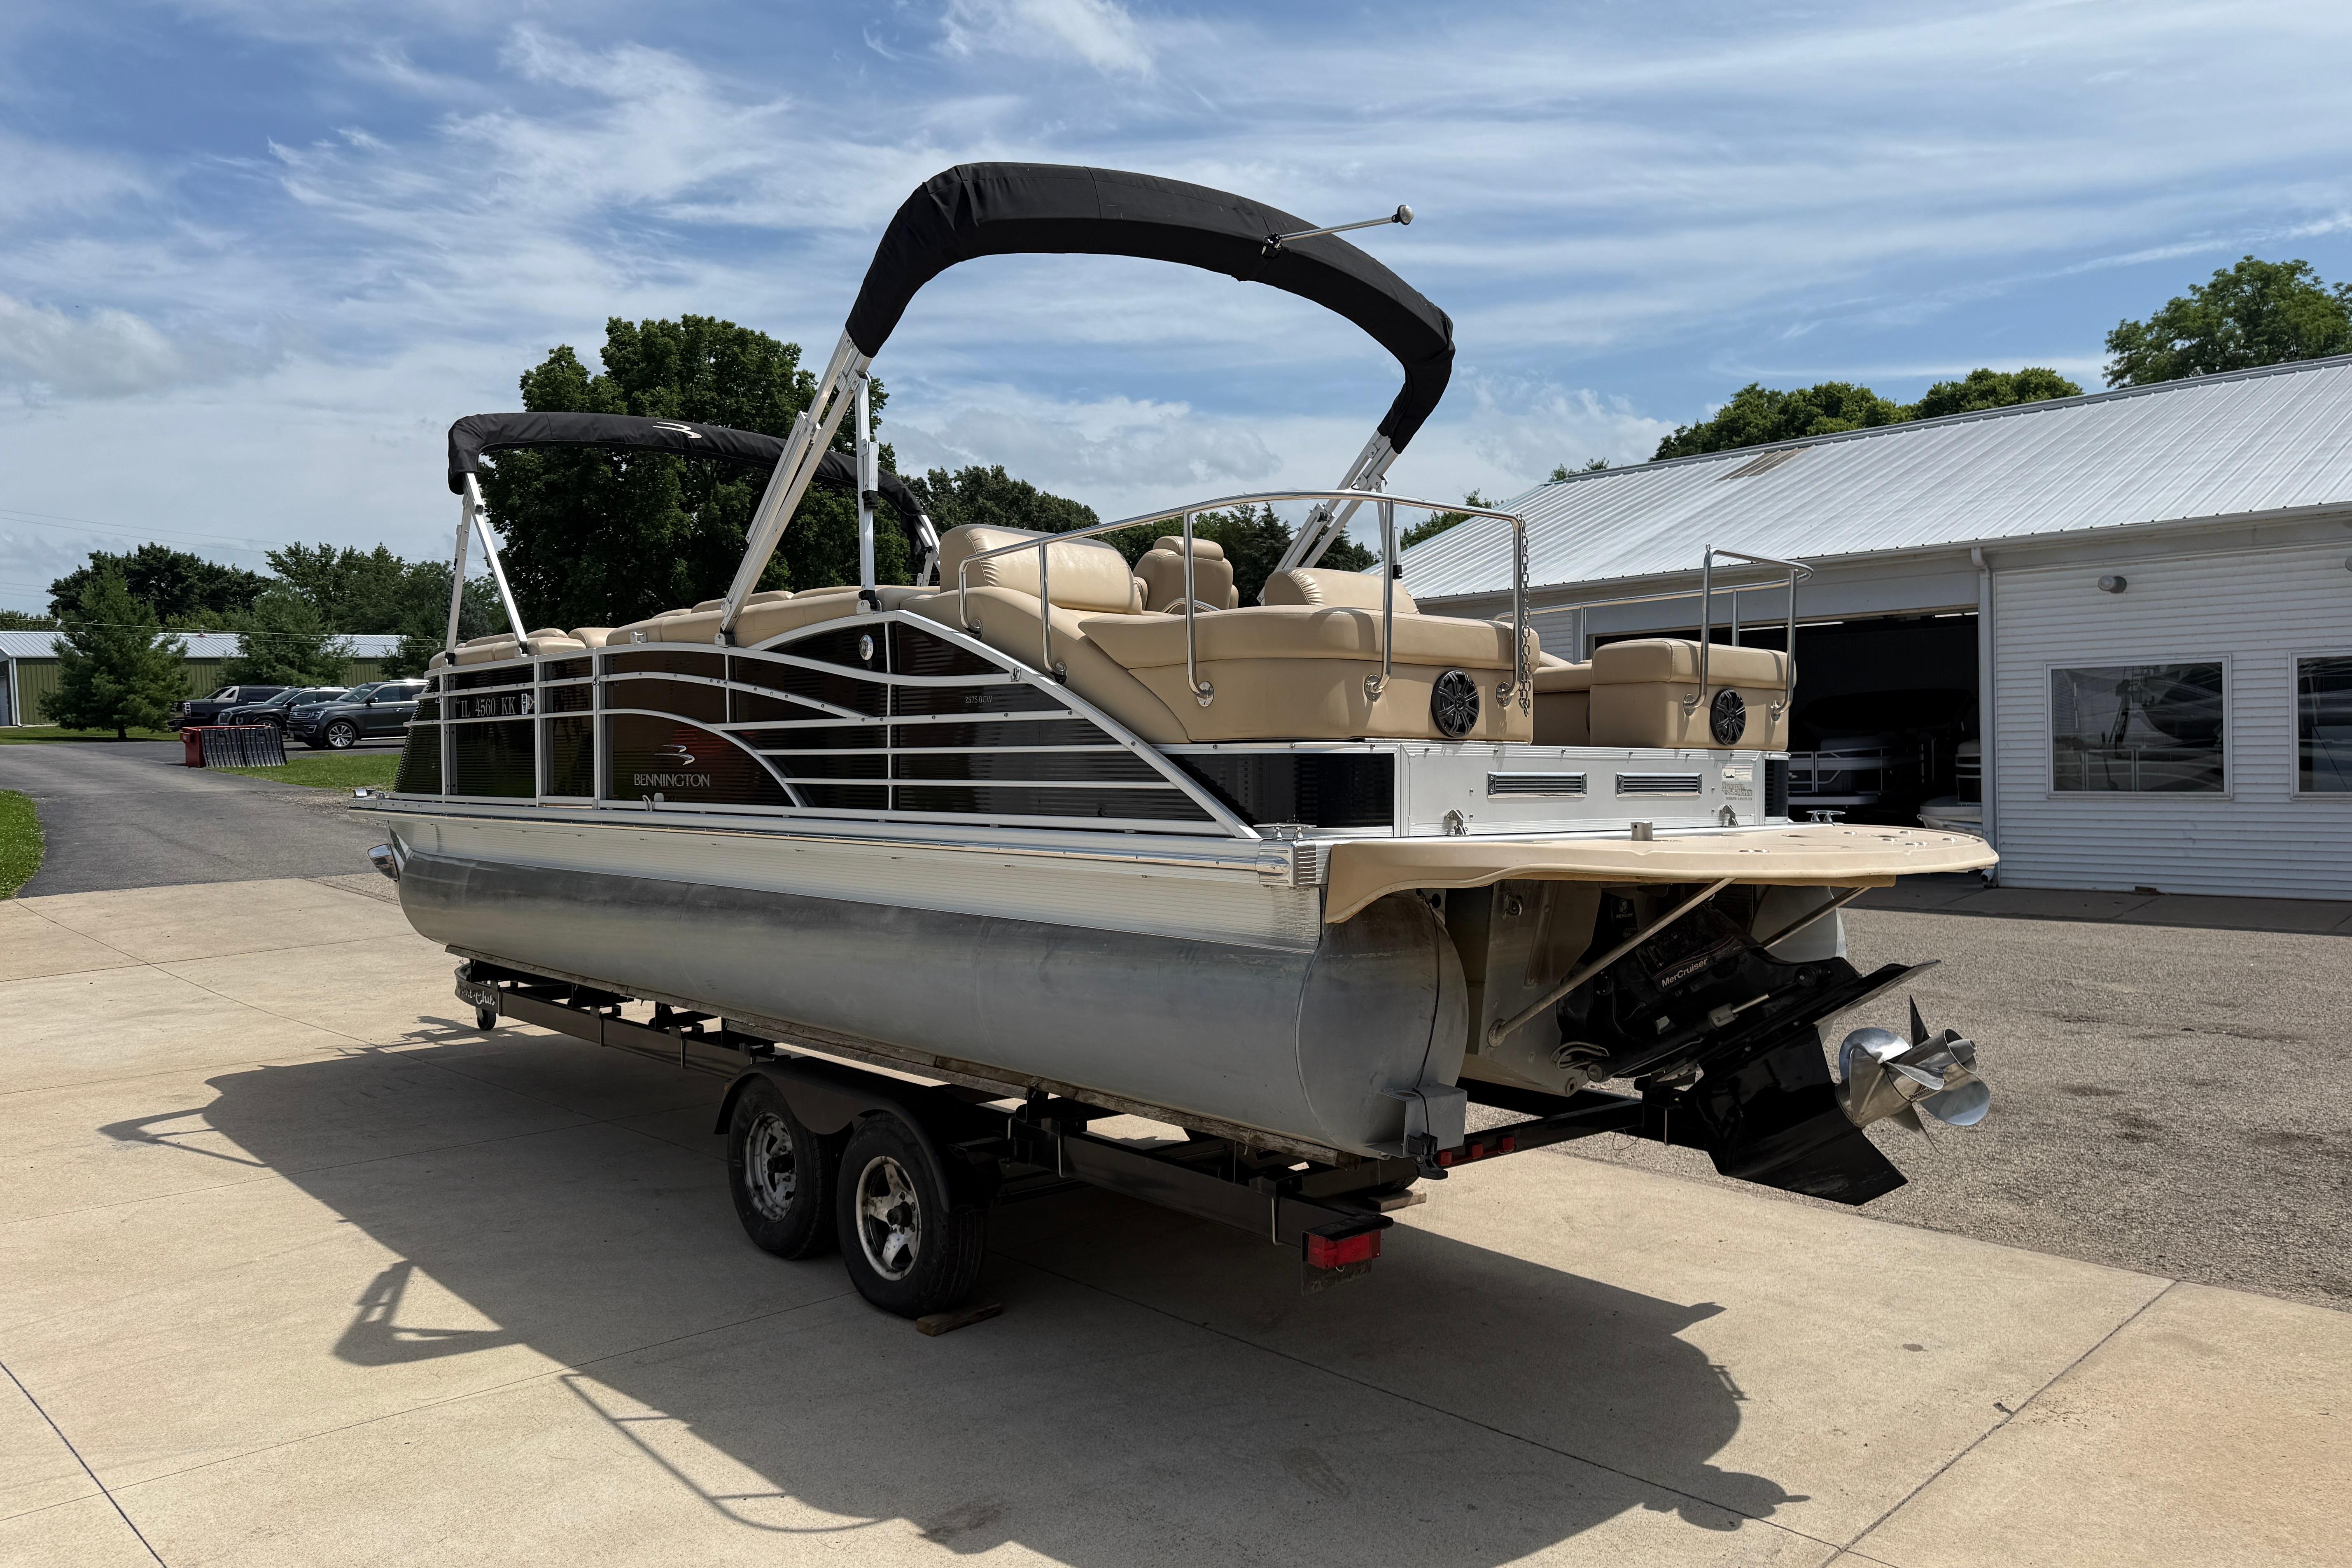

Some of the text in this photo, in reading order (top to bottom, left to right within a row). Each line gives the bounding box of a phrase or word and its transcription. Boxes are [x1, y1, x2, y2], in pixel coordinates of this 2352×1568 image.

[461, 700, 471, 718] IL
[475, 698, 496, 716] 4560
[501, 697, 516, 715] KK
[634, 774, 710, 787] BENNINGTON
[1661, 958, 1708, 987] MerCruiser
[1909, 1087, 1930, 1099] Bravo
